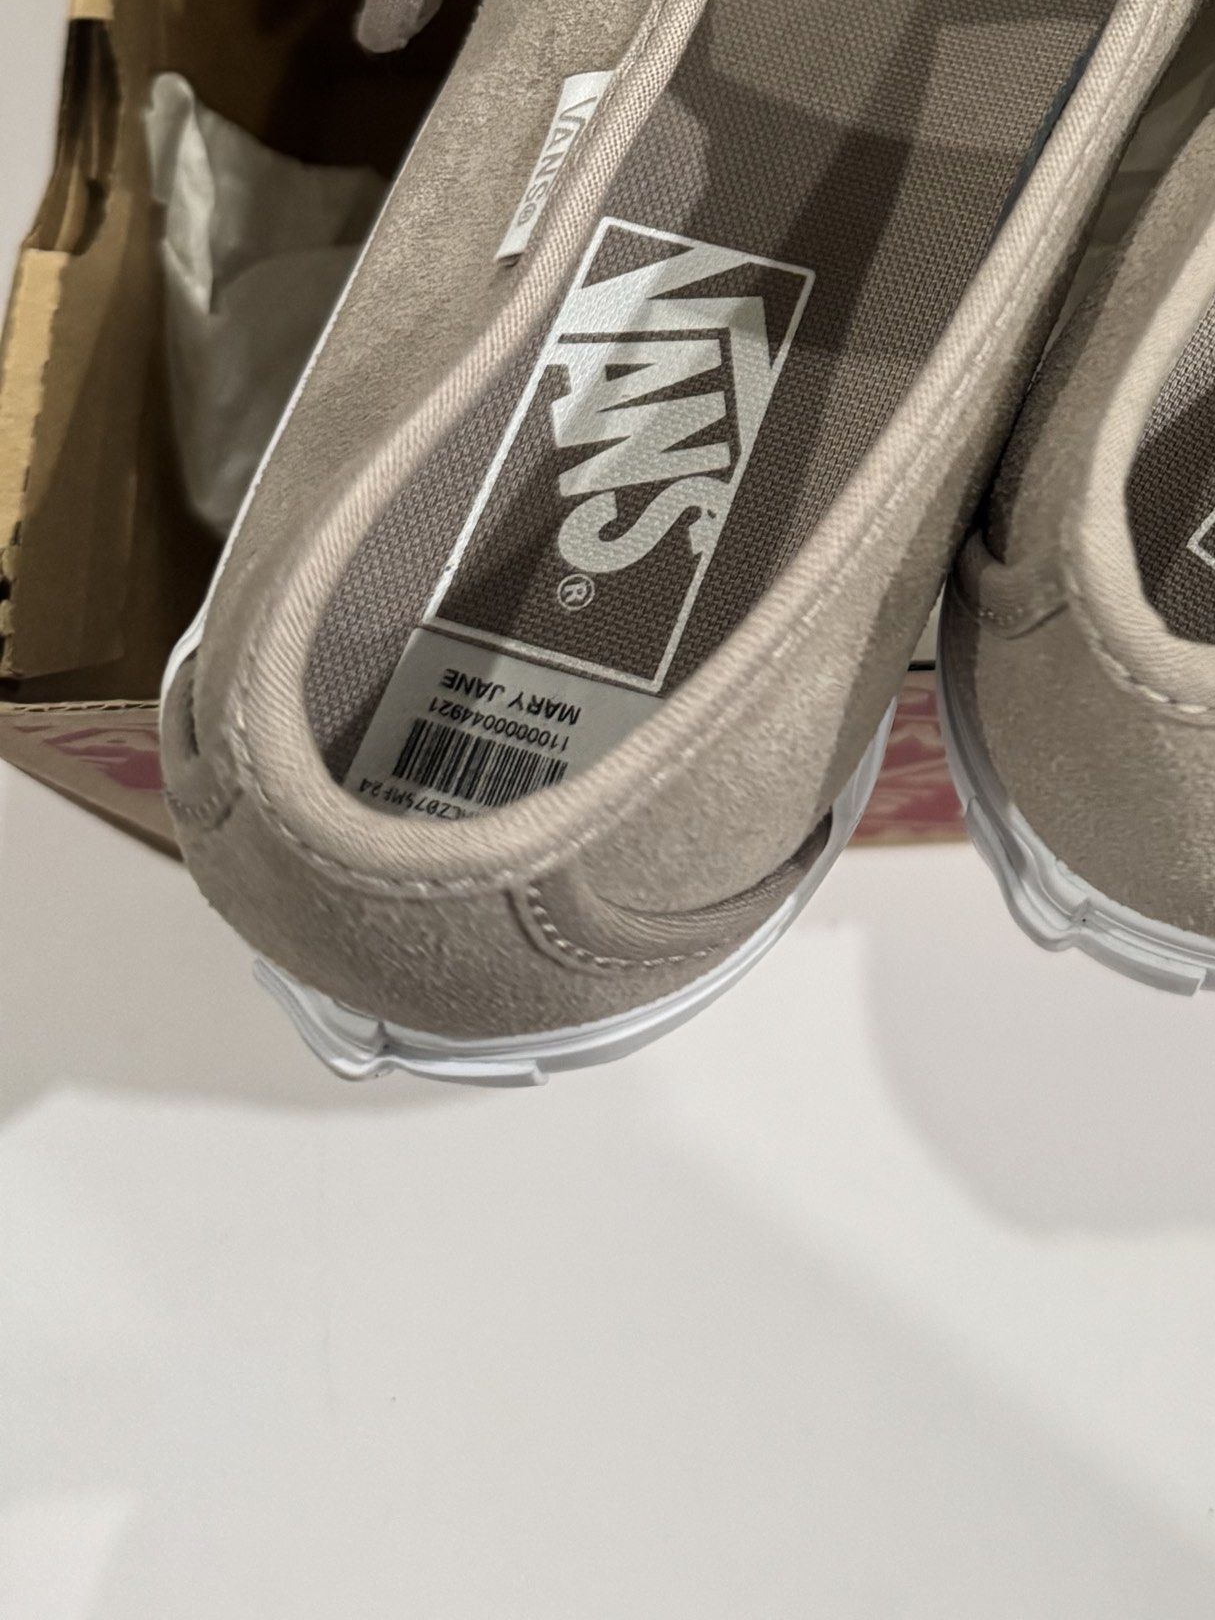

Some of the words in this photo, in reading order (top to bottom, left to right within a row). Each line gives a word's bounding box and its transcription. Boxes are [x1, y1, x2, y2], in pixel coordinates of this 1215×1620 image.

[441, 667, 505, 702] JANE
[428, 695, 570, 753] 1100000044921
[507, 690, 582, 726] MARY
